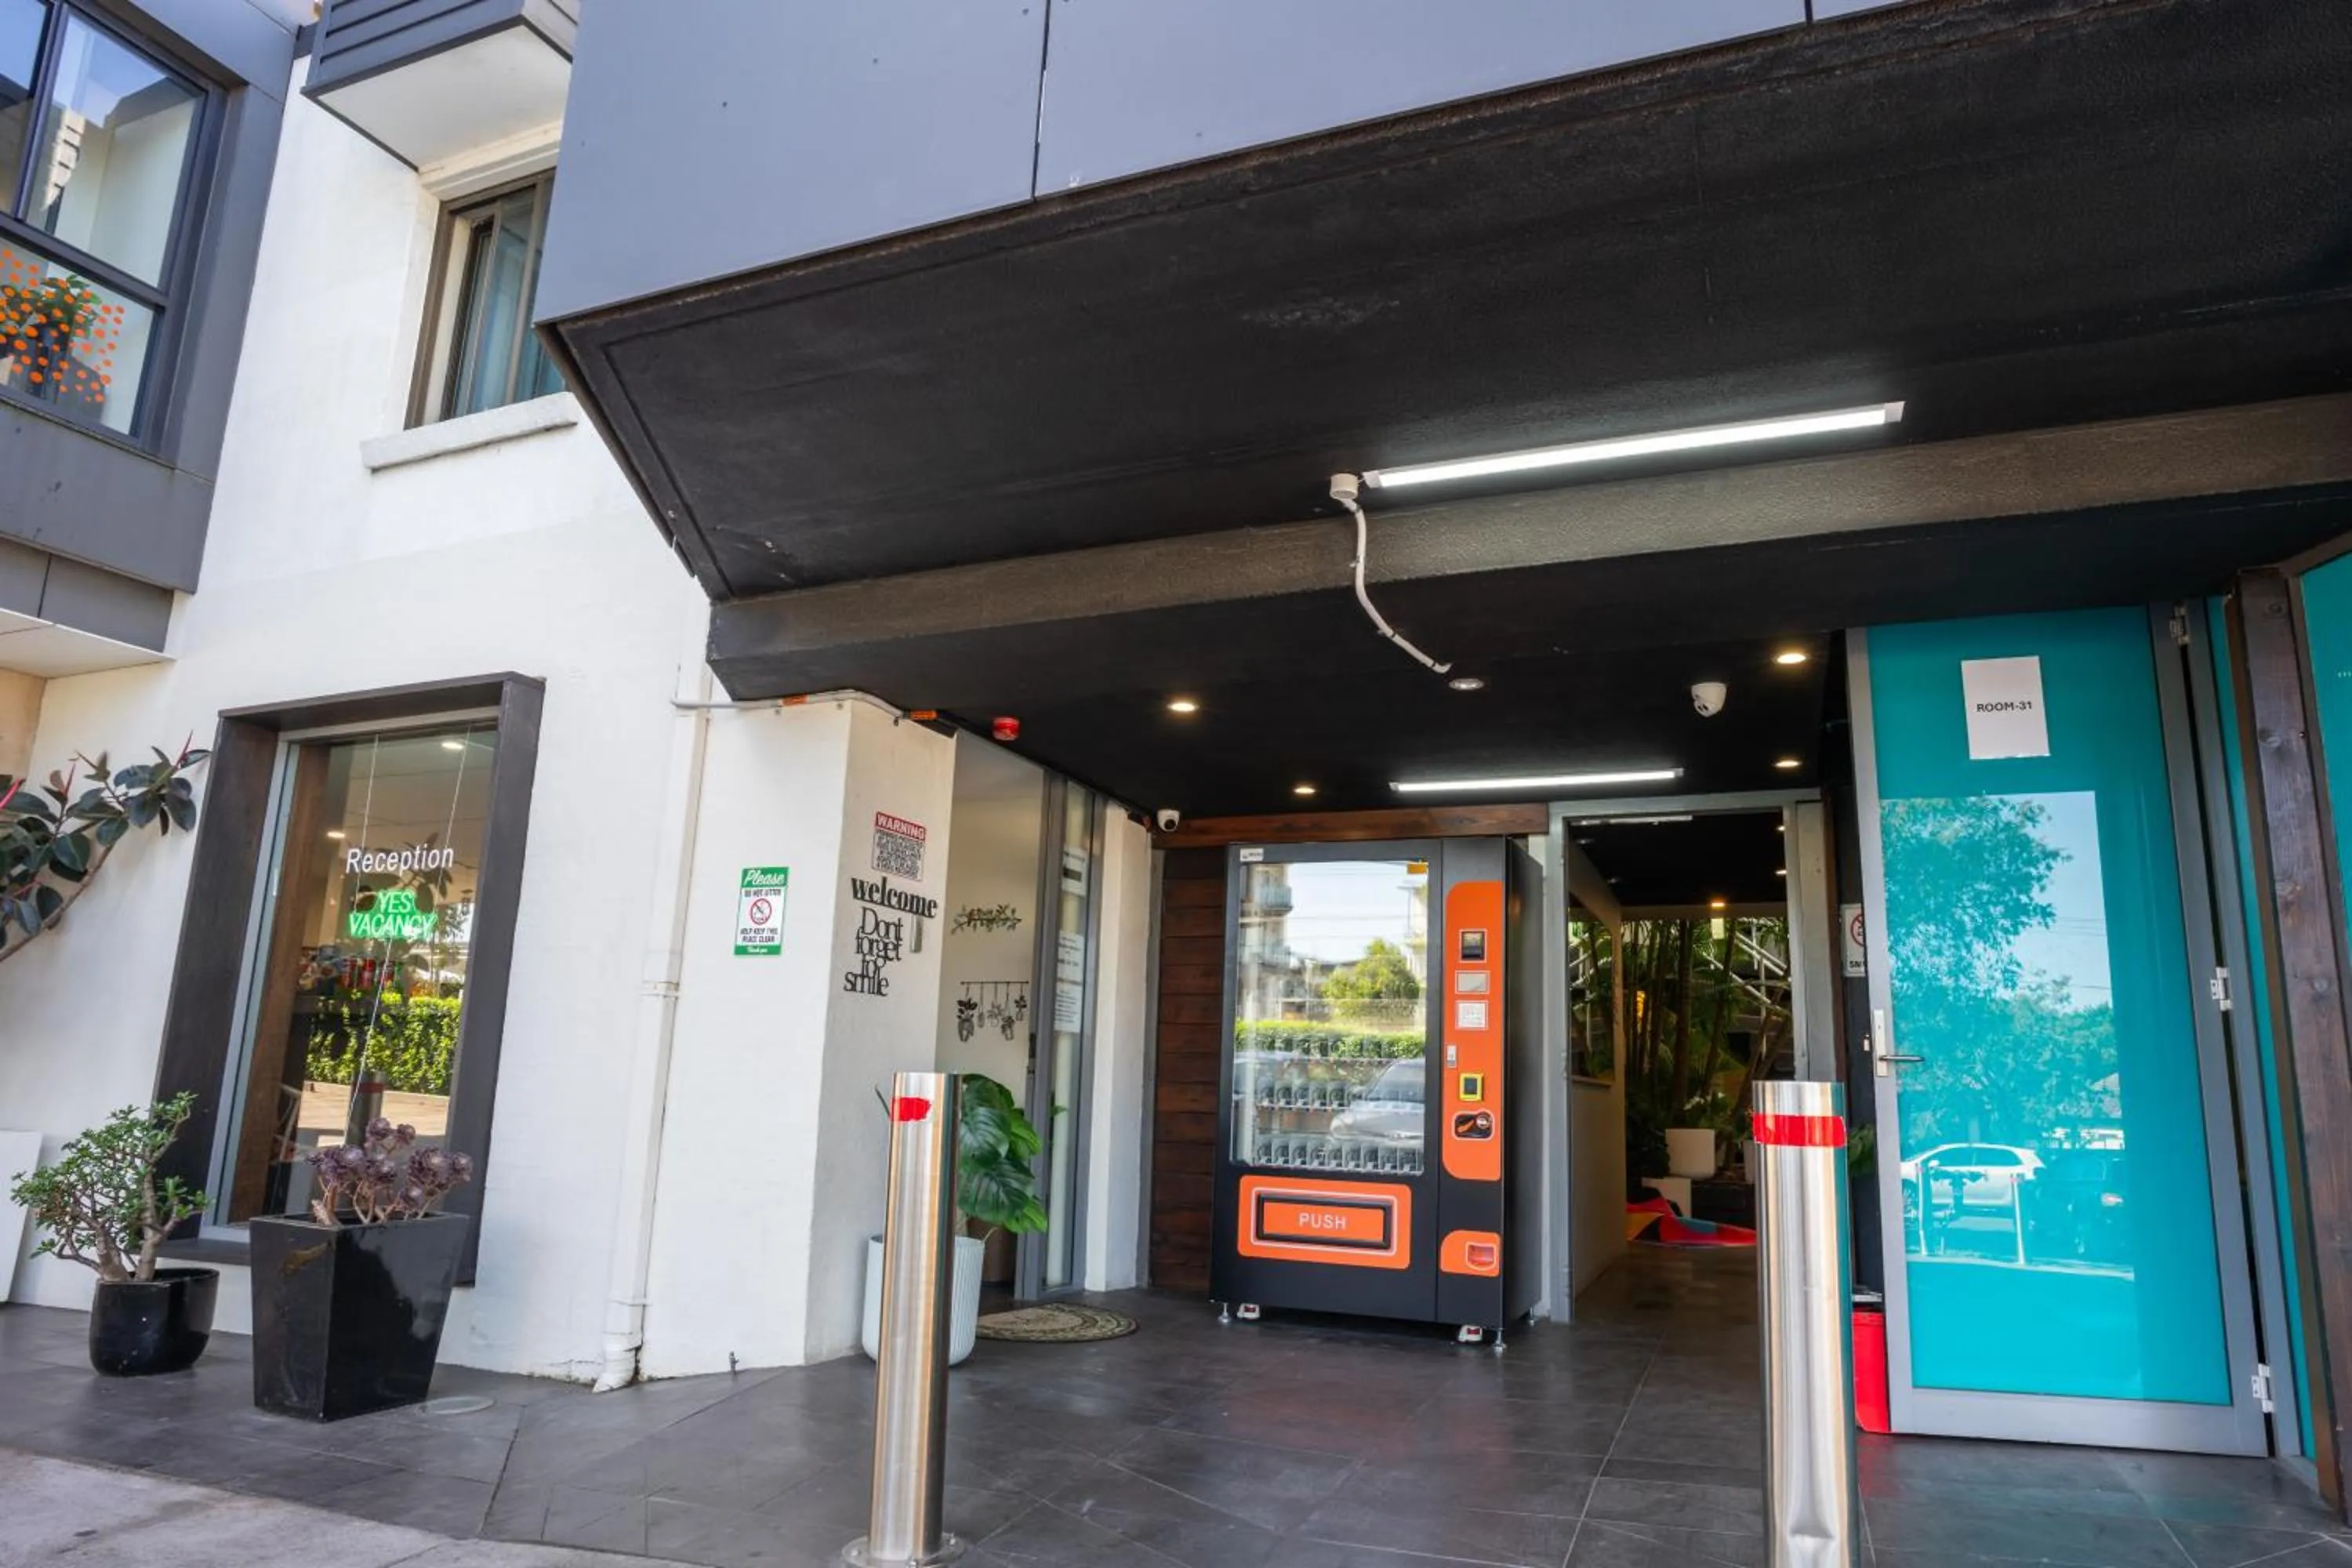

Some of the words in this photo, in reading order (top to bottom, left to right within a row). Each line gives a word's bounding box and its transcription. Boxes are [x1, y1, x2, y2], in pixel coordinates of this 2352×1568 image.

[1976, 700, 2032, 713] ROOM-31
[877, 812, 925, 840] WARNING
[346, 843, 454, 877] Reception
[742, 869, 786, 886] Please
[378, 891, 414, 913] YES
[851, 876, 938, 918] welcome
[350, 913, 437, 938] VACANCY
[862, 906, 903, 941] Dont
[855, 926, 902, 967] forget
[844, 969, 889, 996] smile
[1298, 1212, 1347, 1230] PUSH
